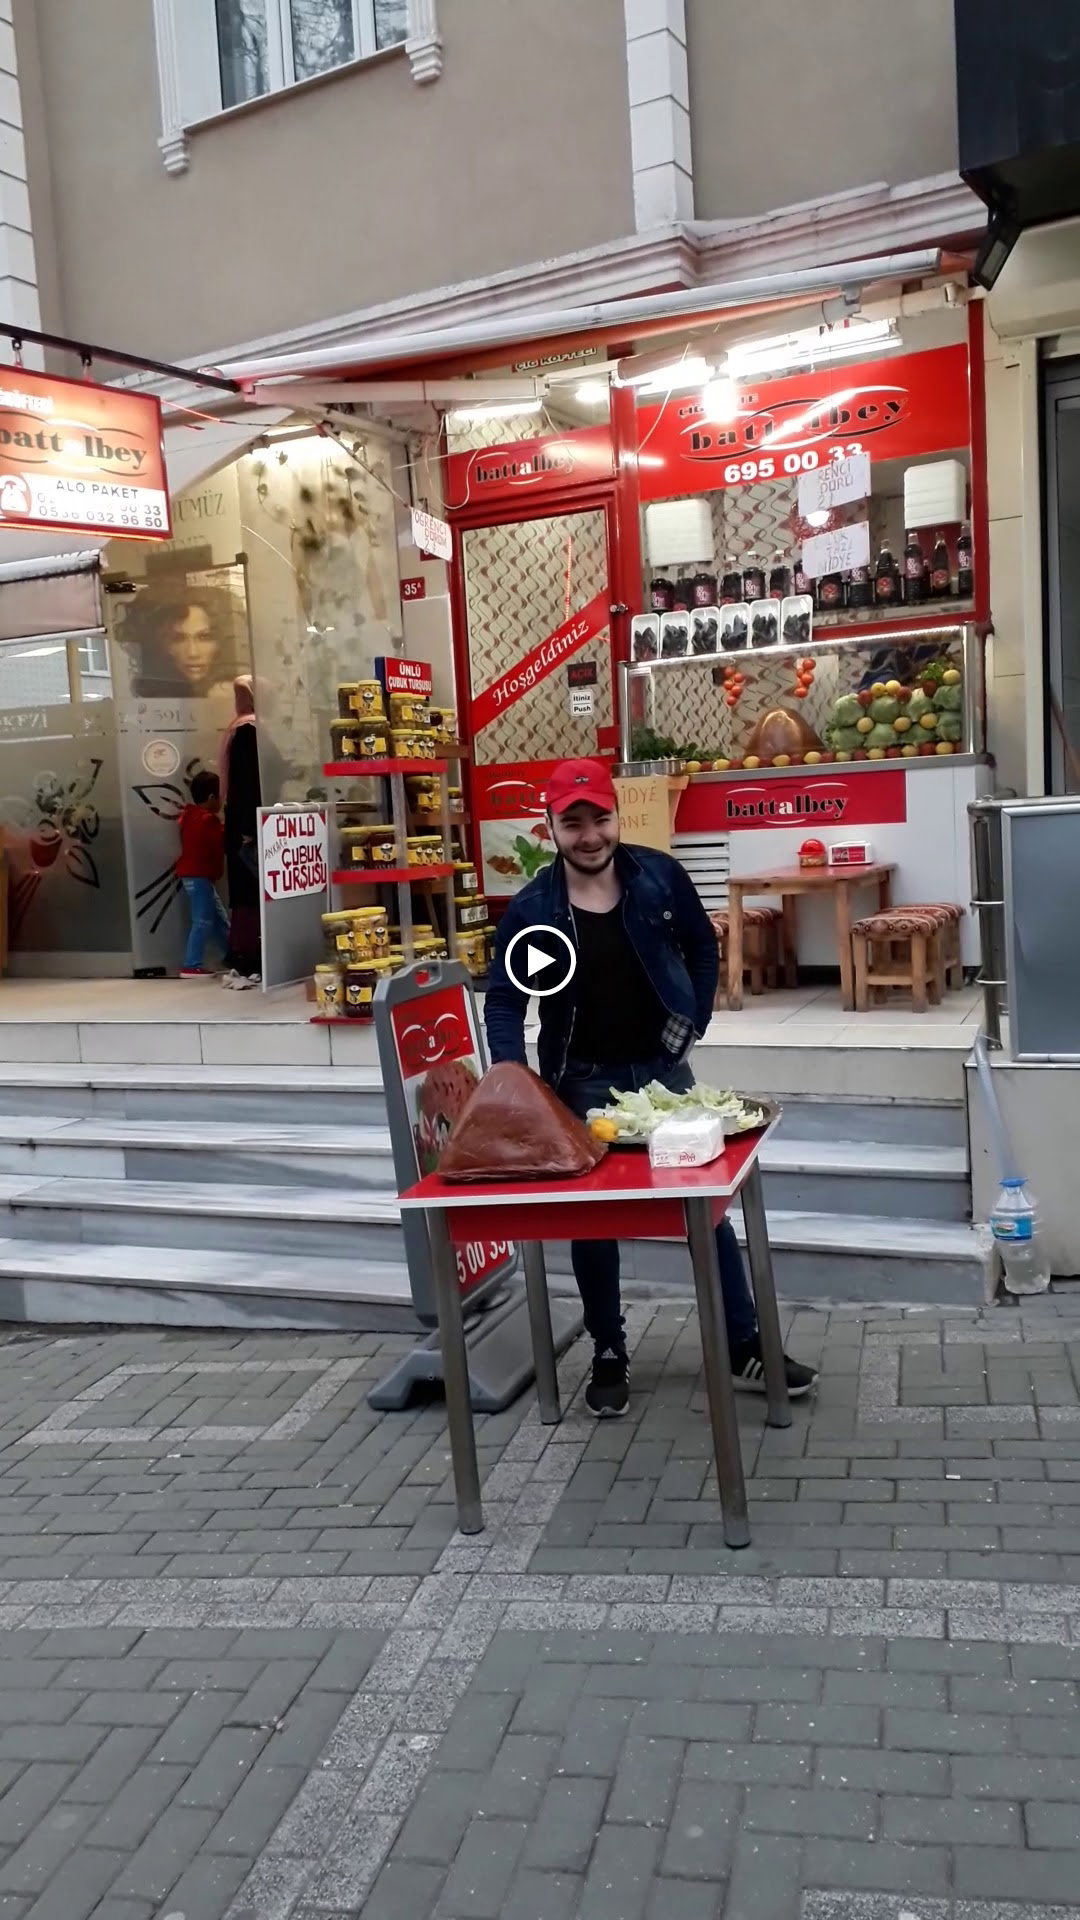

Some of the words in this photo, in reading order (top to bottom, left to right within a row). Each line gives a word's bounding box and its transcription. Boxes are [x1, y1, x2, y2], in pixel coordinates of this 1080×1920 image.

[724, 460, 775, 483] 695
[783, 451, 818, 474] 00
[56, 480, 86, 493] ALO
[92, 484, 139, 499] PAKET
[144, 504, 161, 516] 33
[121, 515, 139, 526] 96
[145, 517, 163, 528] 50
[399, 662, 422, 677] ÜNLÜ
[492, 620, 589, 706] Hoşgeldiniz
[388, 676, 408, 689] ÇUBUK
[727, 795, 849, 819] battalbey
[281, 842, 323, 870] ÇUBUK
[267, 862, 327, 893] TURŞUSU
